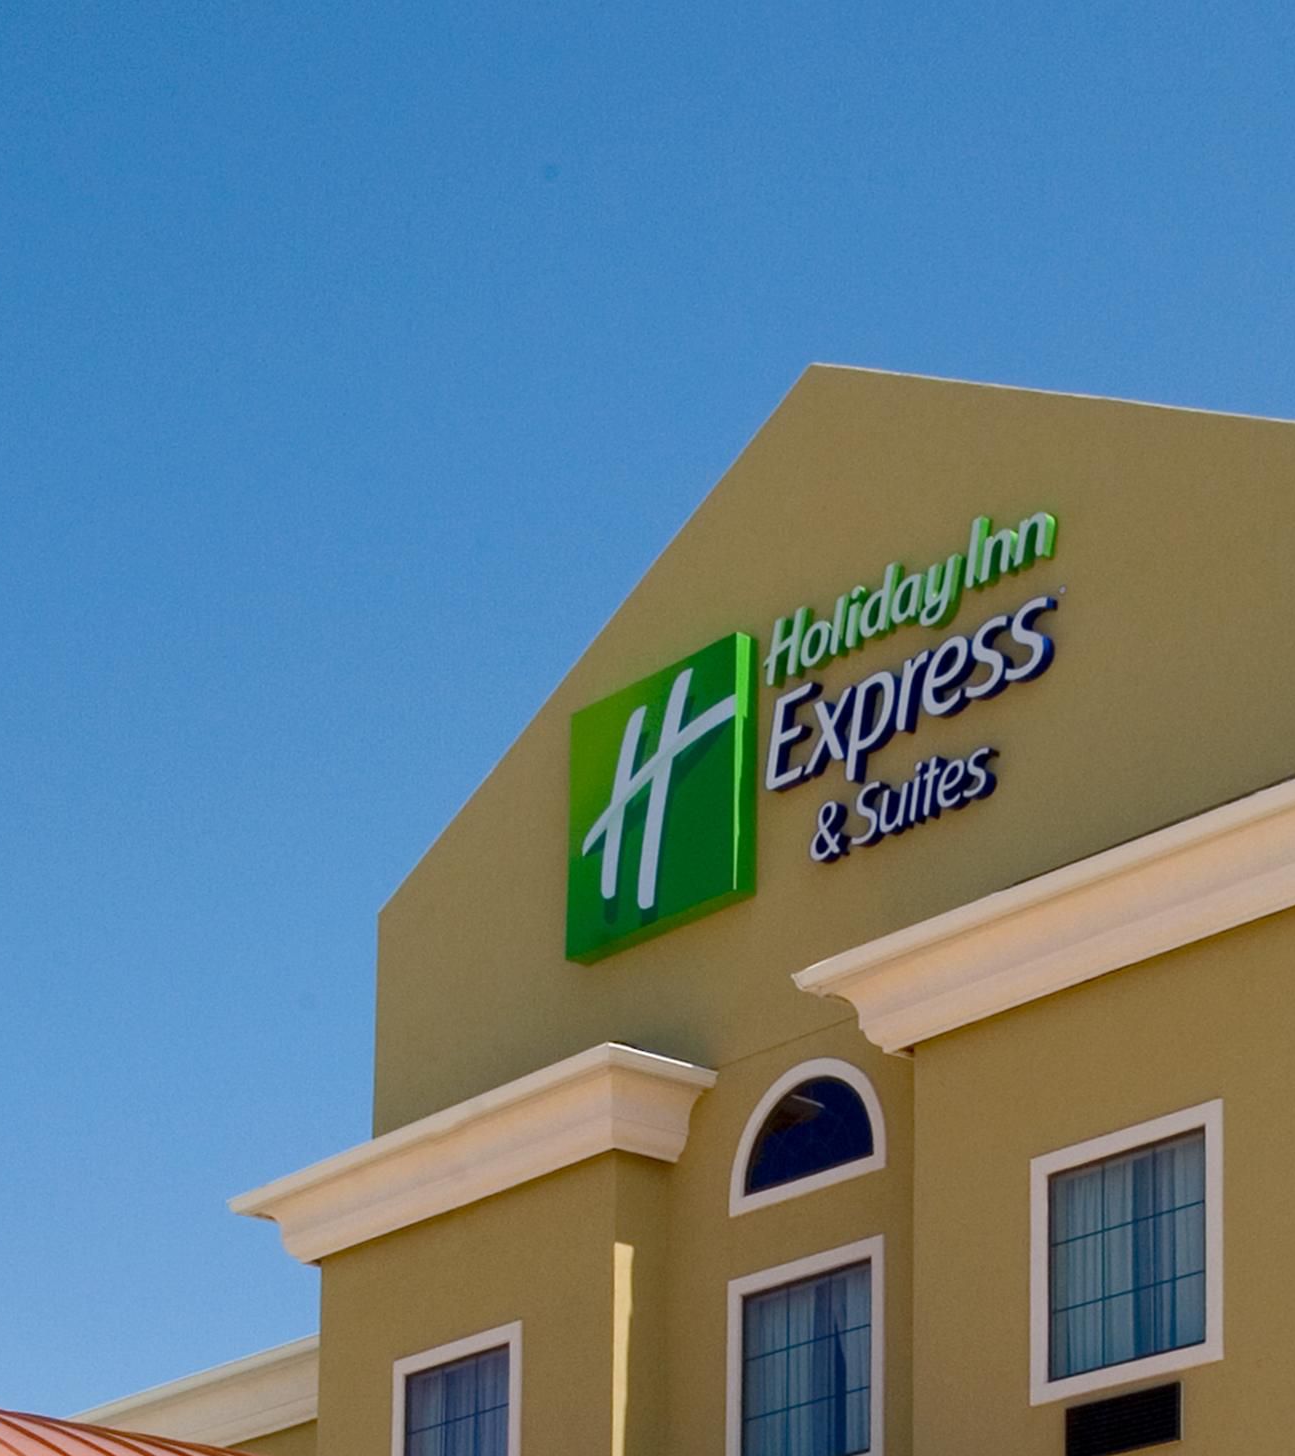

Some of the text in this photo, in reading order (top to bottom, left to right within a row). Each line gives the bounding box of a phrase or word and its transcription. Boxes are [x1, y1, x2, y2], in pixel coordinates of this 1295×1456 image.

[762, 511, 1057, 687] Holiday Inn
[764, 596, 1058, 791] Express
[809, 747, 1000, 862] & Suites
